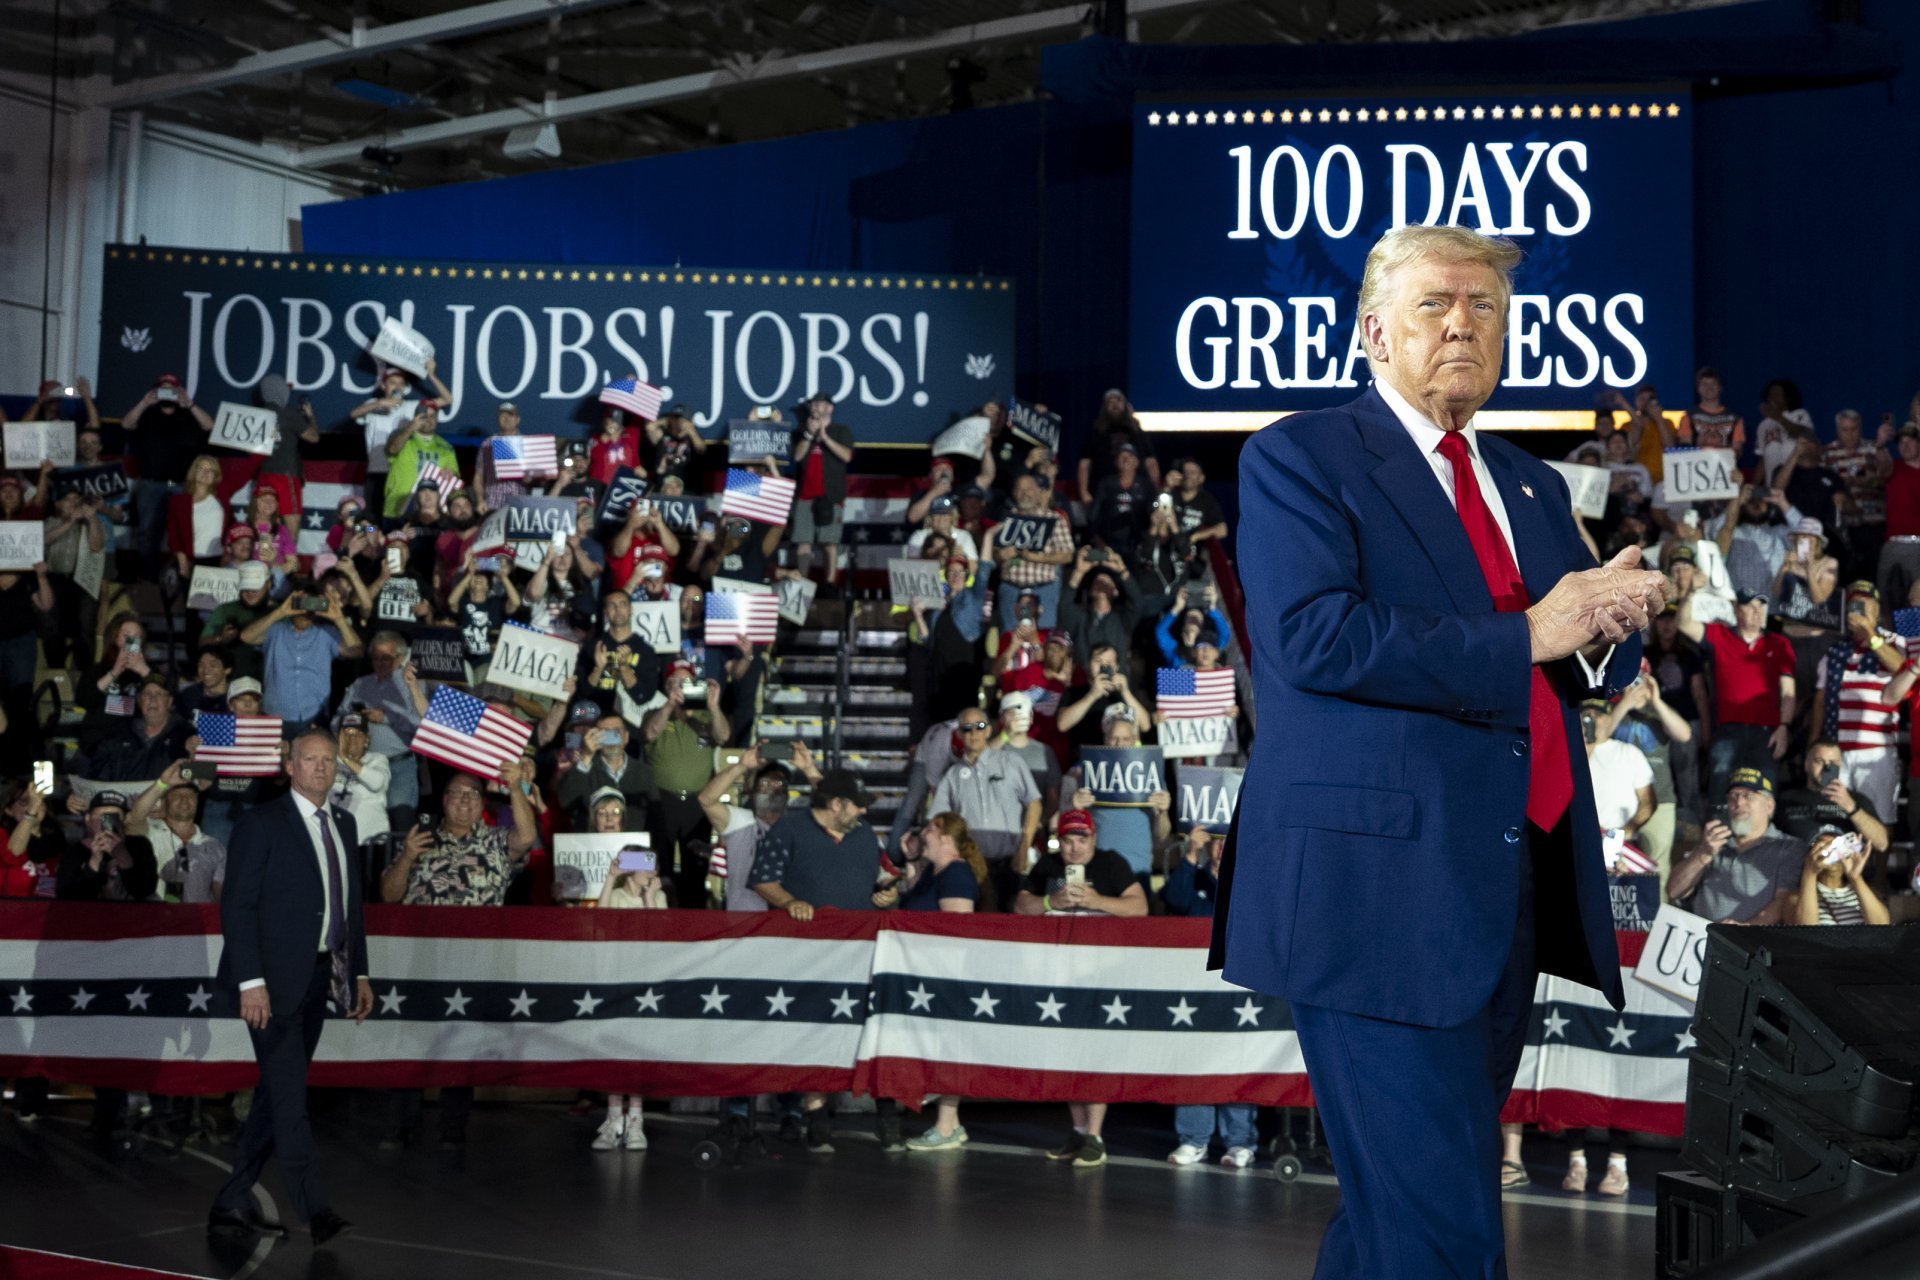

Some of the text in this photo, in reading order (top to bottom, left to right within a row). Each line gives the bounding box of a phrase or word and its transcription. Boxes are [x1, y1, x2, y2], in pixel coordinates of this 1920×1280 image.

[1226, 139, 1593, 240] 100 DAYS
[1175, 294, 1648, 390] GREESS
[436, 303, 675, 424] JOBS!
[692, 311, 930, 428] JOBS!
[221, 410, 267, 446] USA
[1013, 402, 1060, 454] MAGA
[1673, 460, 1730, 493] USA
[602, 477, 648, 520] USA
[508, 506, 577, 536] MAGA
[1000, 516, 1047, 549] USA
[892, 571, 942, 598] MAGA
[636, 611, 672, 643] SA
[495, 641, 569, 685] MAGA
[1162, 717, 1235, 744] MAGA
[1083, 760, 1160, 792] MAGA
[1180, 784, 1238, 824] MA
[557, 850, 615, 867] GOLDEN
[1656, 922, 1708, 986] US
